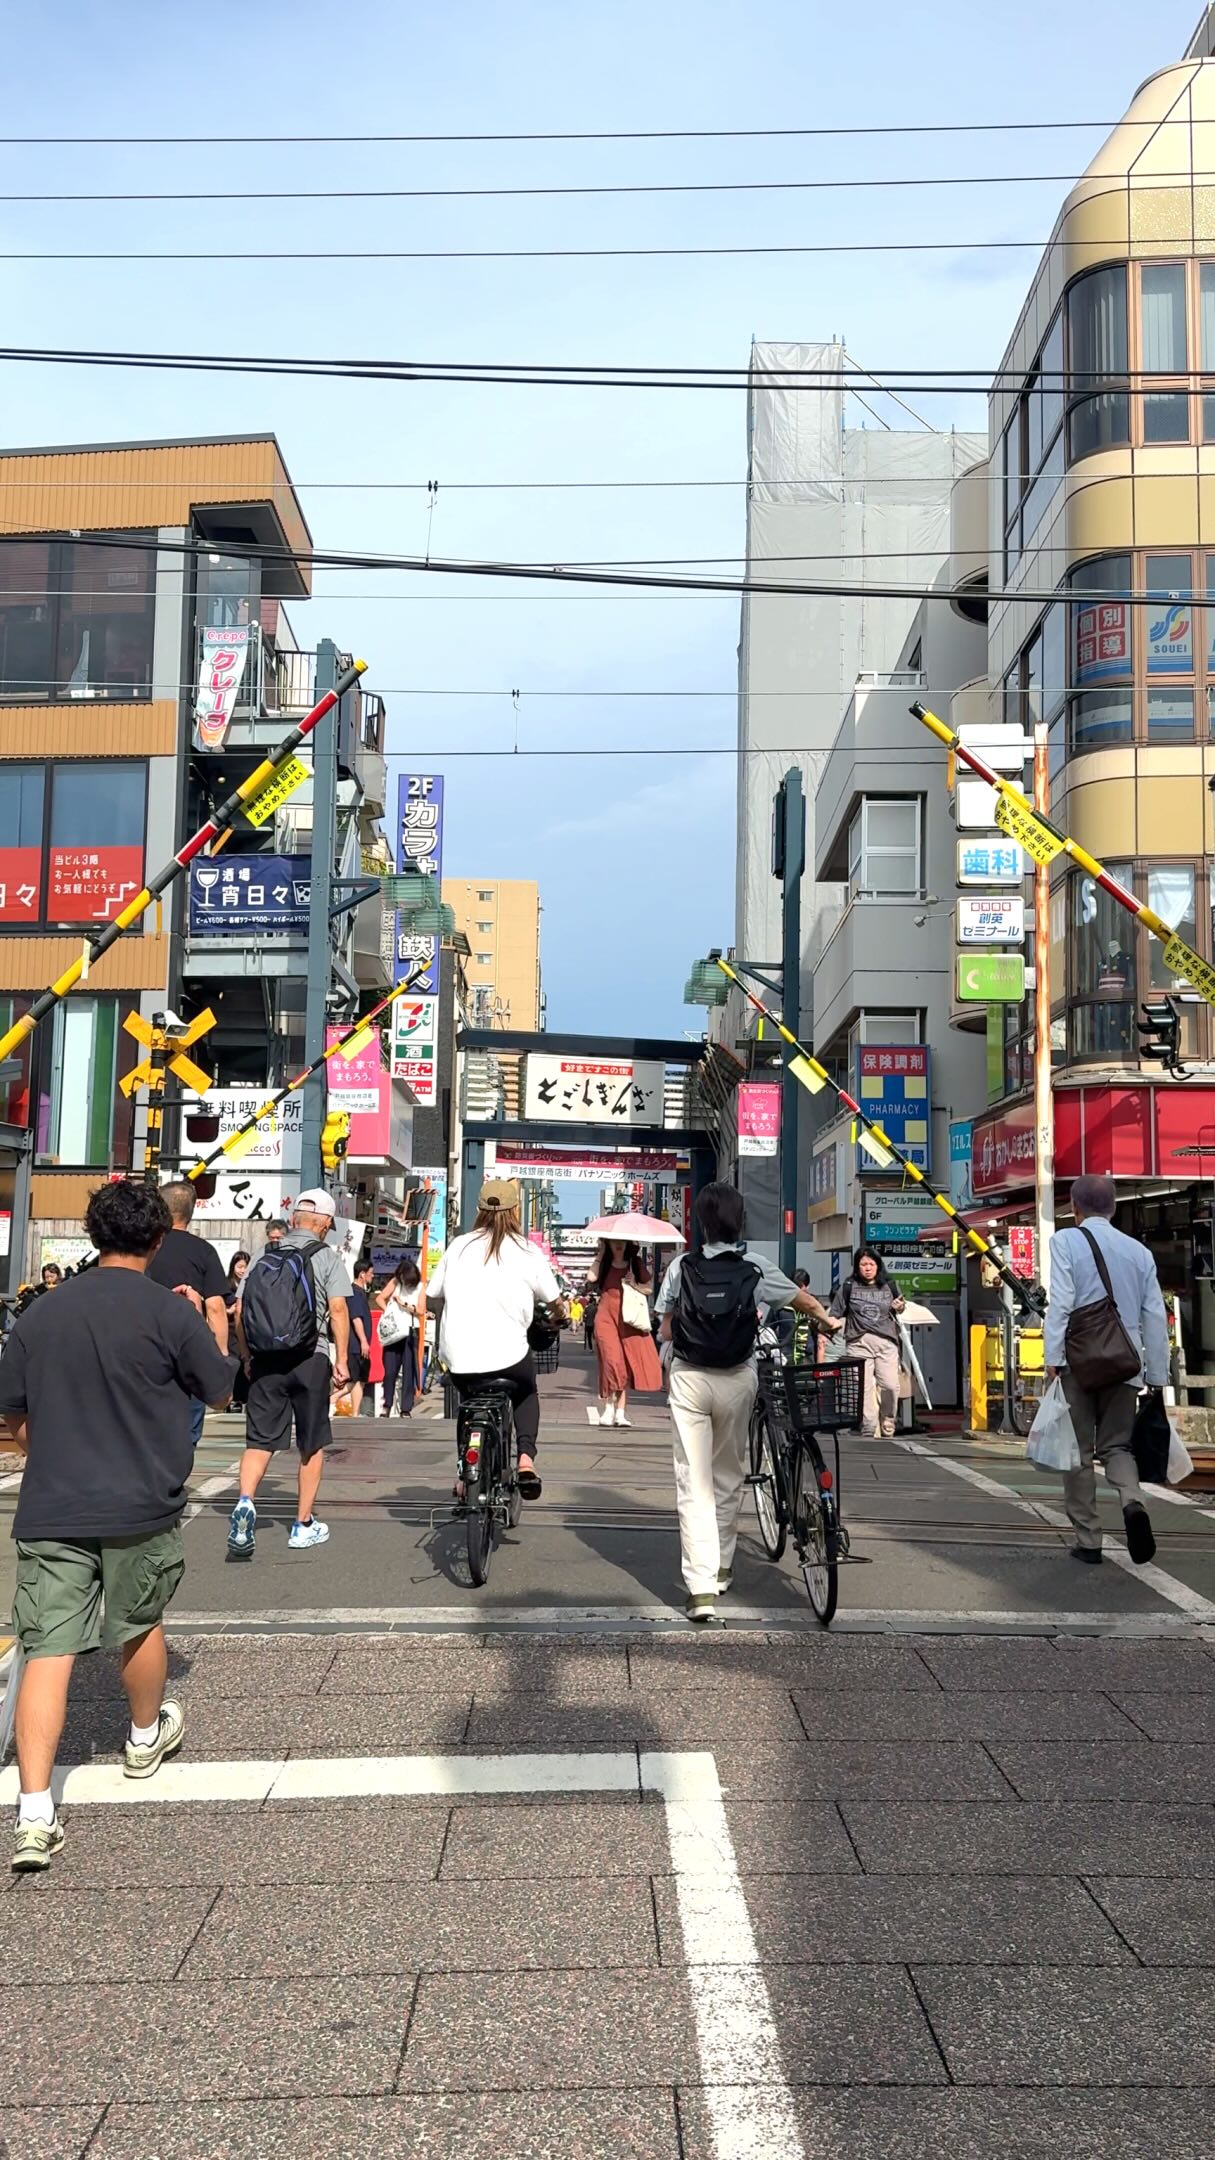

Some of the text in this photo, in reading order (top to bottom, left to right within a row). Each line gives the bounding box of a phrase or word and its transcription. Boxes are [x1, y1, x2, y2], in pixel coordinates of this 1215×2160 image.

[1154, 643, 1187, 654] SOUEI
[206, 651, 237, 730] クレープ
[407, 777, 434, 796] 2F
[254, 772, 304, 820] おやめ下さい
[995, 809, 1046, 861] おやめ下さい
[54, 854, 99, 866] 当ビル3階
[962, 848, 1020, 876] 歯科
[54, 868, 108, 880] お一人様でも
[222, 867, 251, 882] 酒場
[54, 883, 117, 895] お気軽にどうぞ
[221, 884, 289, 907] 宵日々
[962, 926, 1020, 938] ゼミナール
[405, 1045, 423, 1058] 酒
[863, 1053, 923, 1070] 保険調剤
[396, 1063, 432, 1076] たばこ
[335, 1072, 372, 1083] まもろう。
[537, 1077, 654, 1116] とごしぎんざ
[869, 1103, 920, 1115] PHARMACY
[338, 1143, 342, 1153] 1
[627, 1171, 661, 1181] ホームズ
[869, 1211, 882, 1220] 6F
[894, 1261, 952, 1270] 創英ゼミナール
